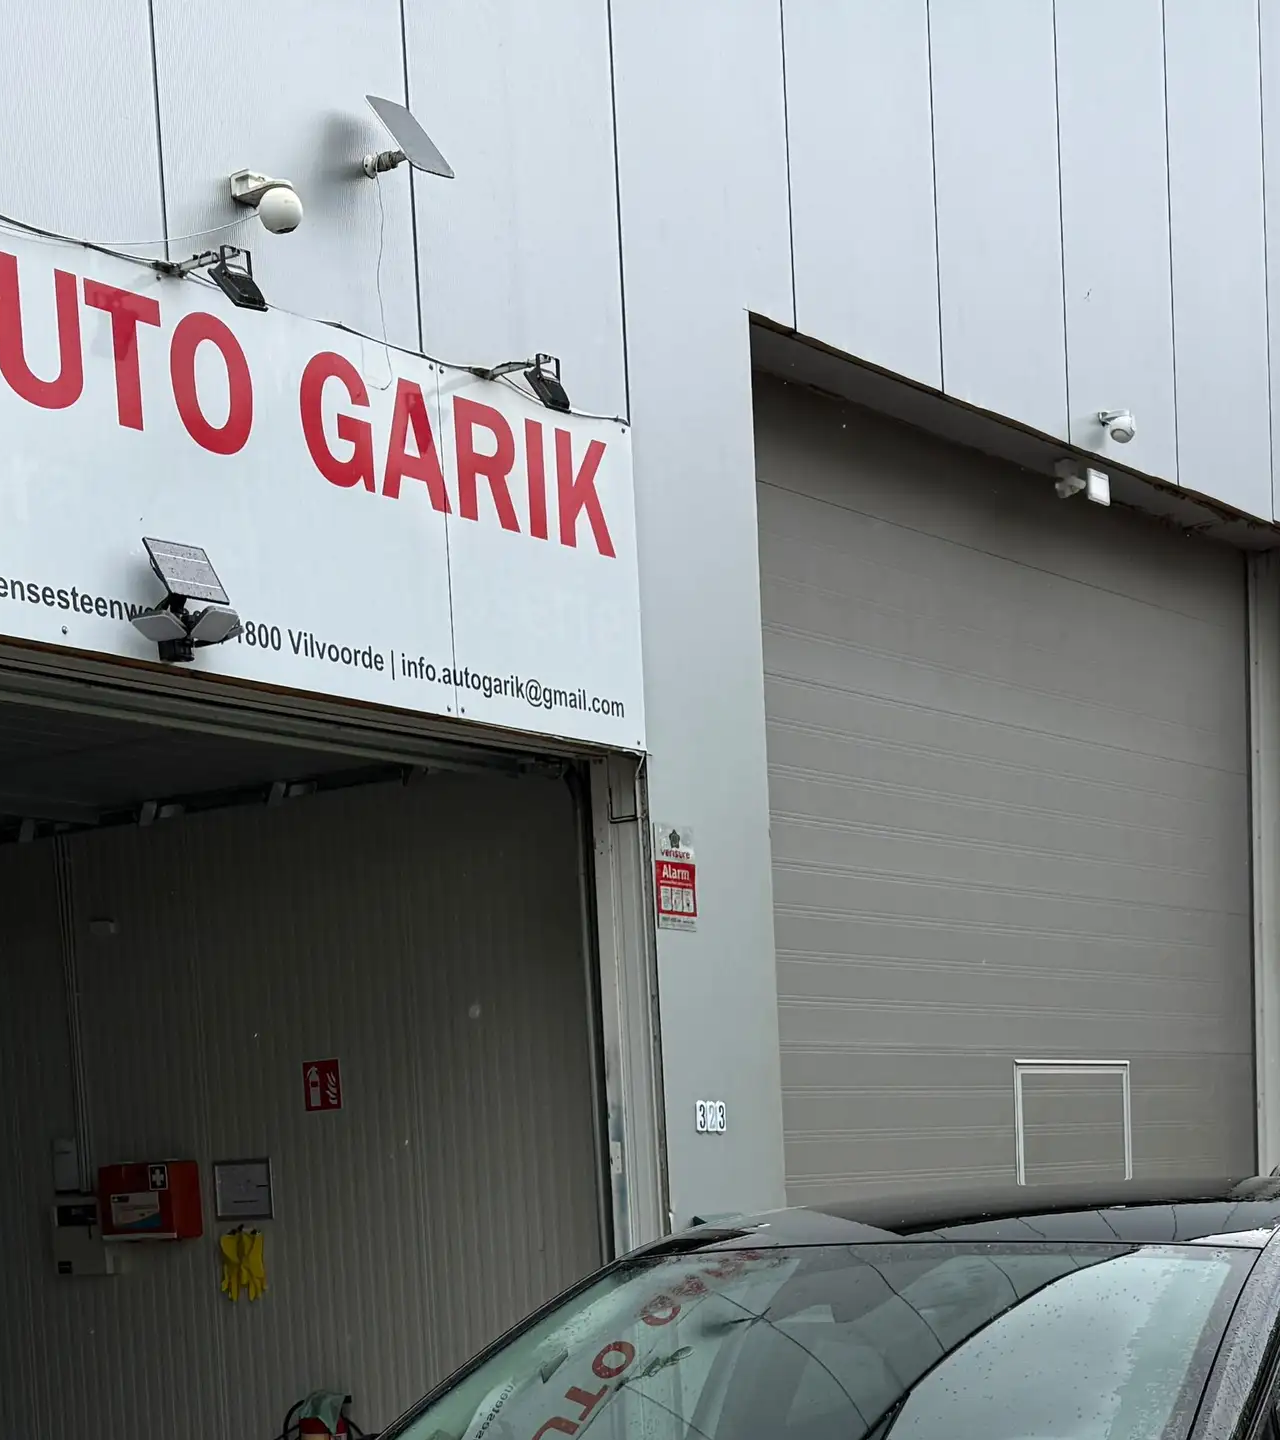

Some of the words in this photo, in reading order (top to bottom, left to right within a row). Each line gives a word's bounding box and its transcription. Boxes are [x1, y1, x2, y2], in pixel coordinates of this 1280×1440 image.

[301, 352, 616, 558] GARIK
[287, 629, 385, 672] Vilvoorde
[402, 653, 626, 718] info.autogarik@gmail.com
[662, 864, 689, 880] Alarm
[699, 1103, 726, 1130] 323
